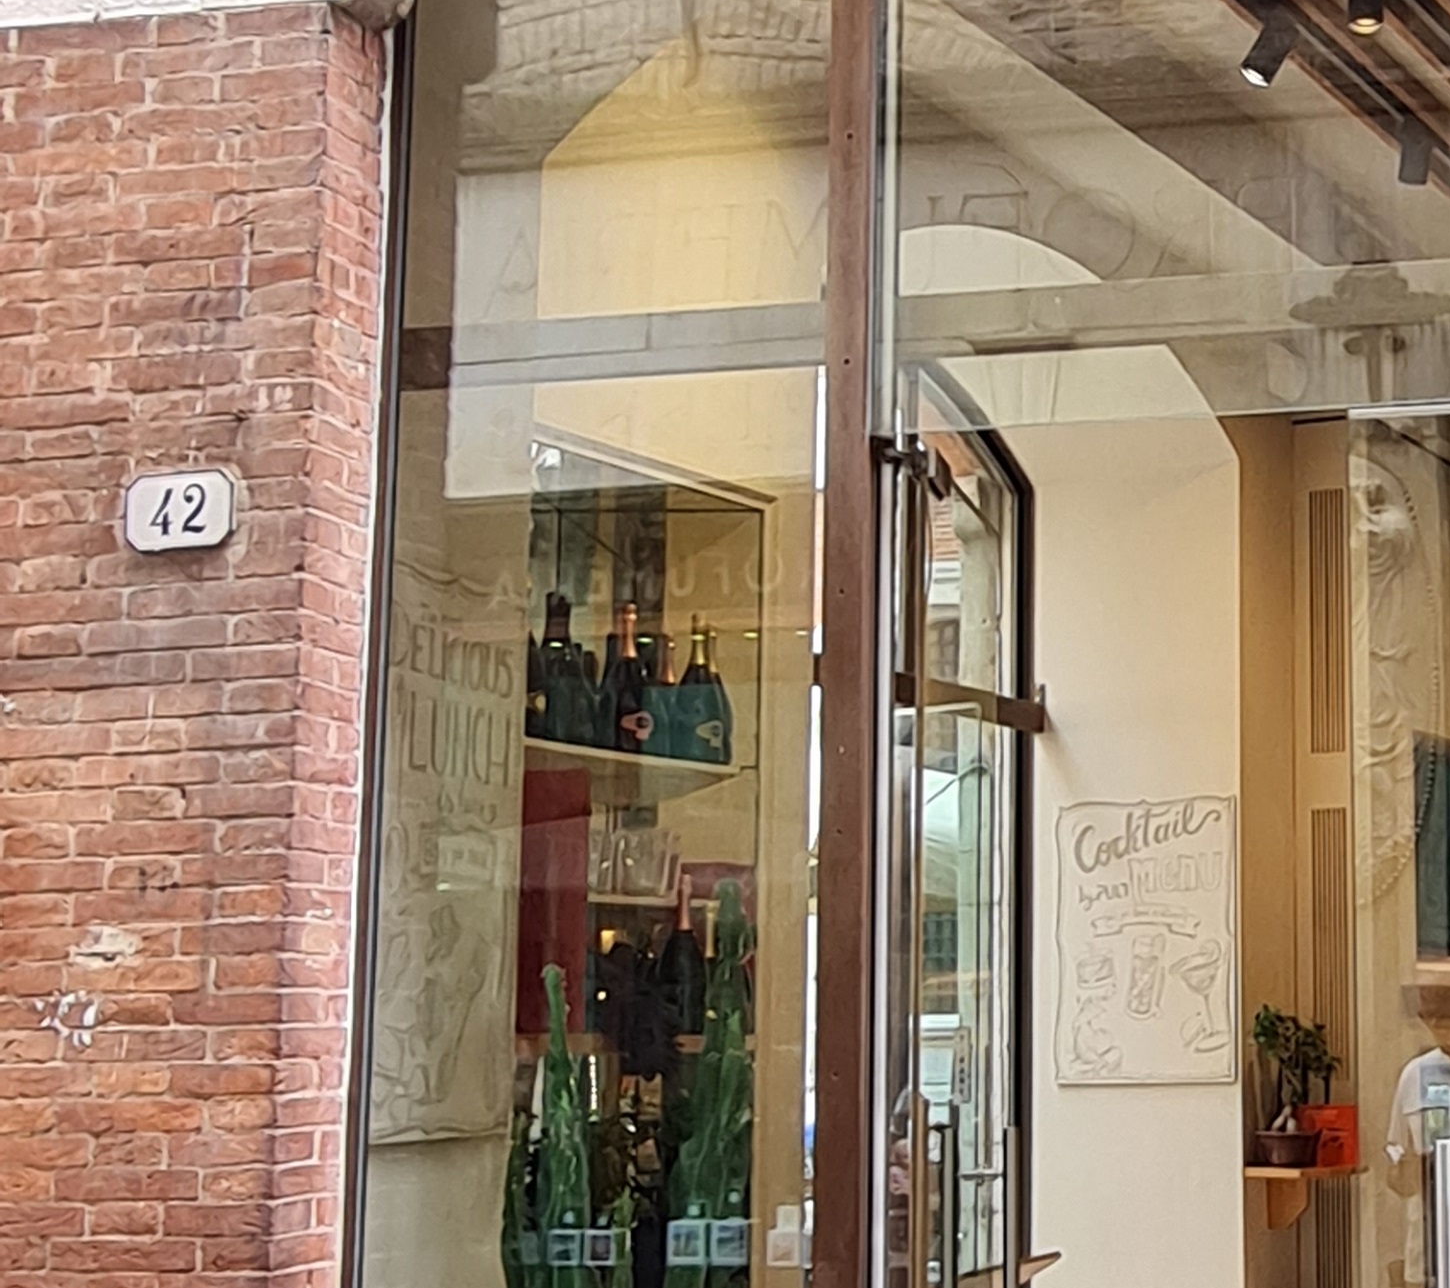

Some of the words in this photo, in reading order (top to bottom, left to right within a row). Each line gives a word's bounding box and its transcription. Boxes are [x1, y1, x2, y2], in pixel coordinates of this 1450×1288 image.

[149, 483, 207, 536] 42
[409, 690, 513, 788] LUNCH
[1073, 800, 1222, 873] Cocktail
